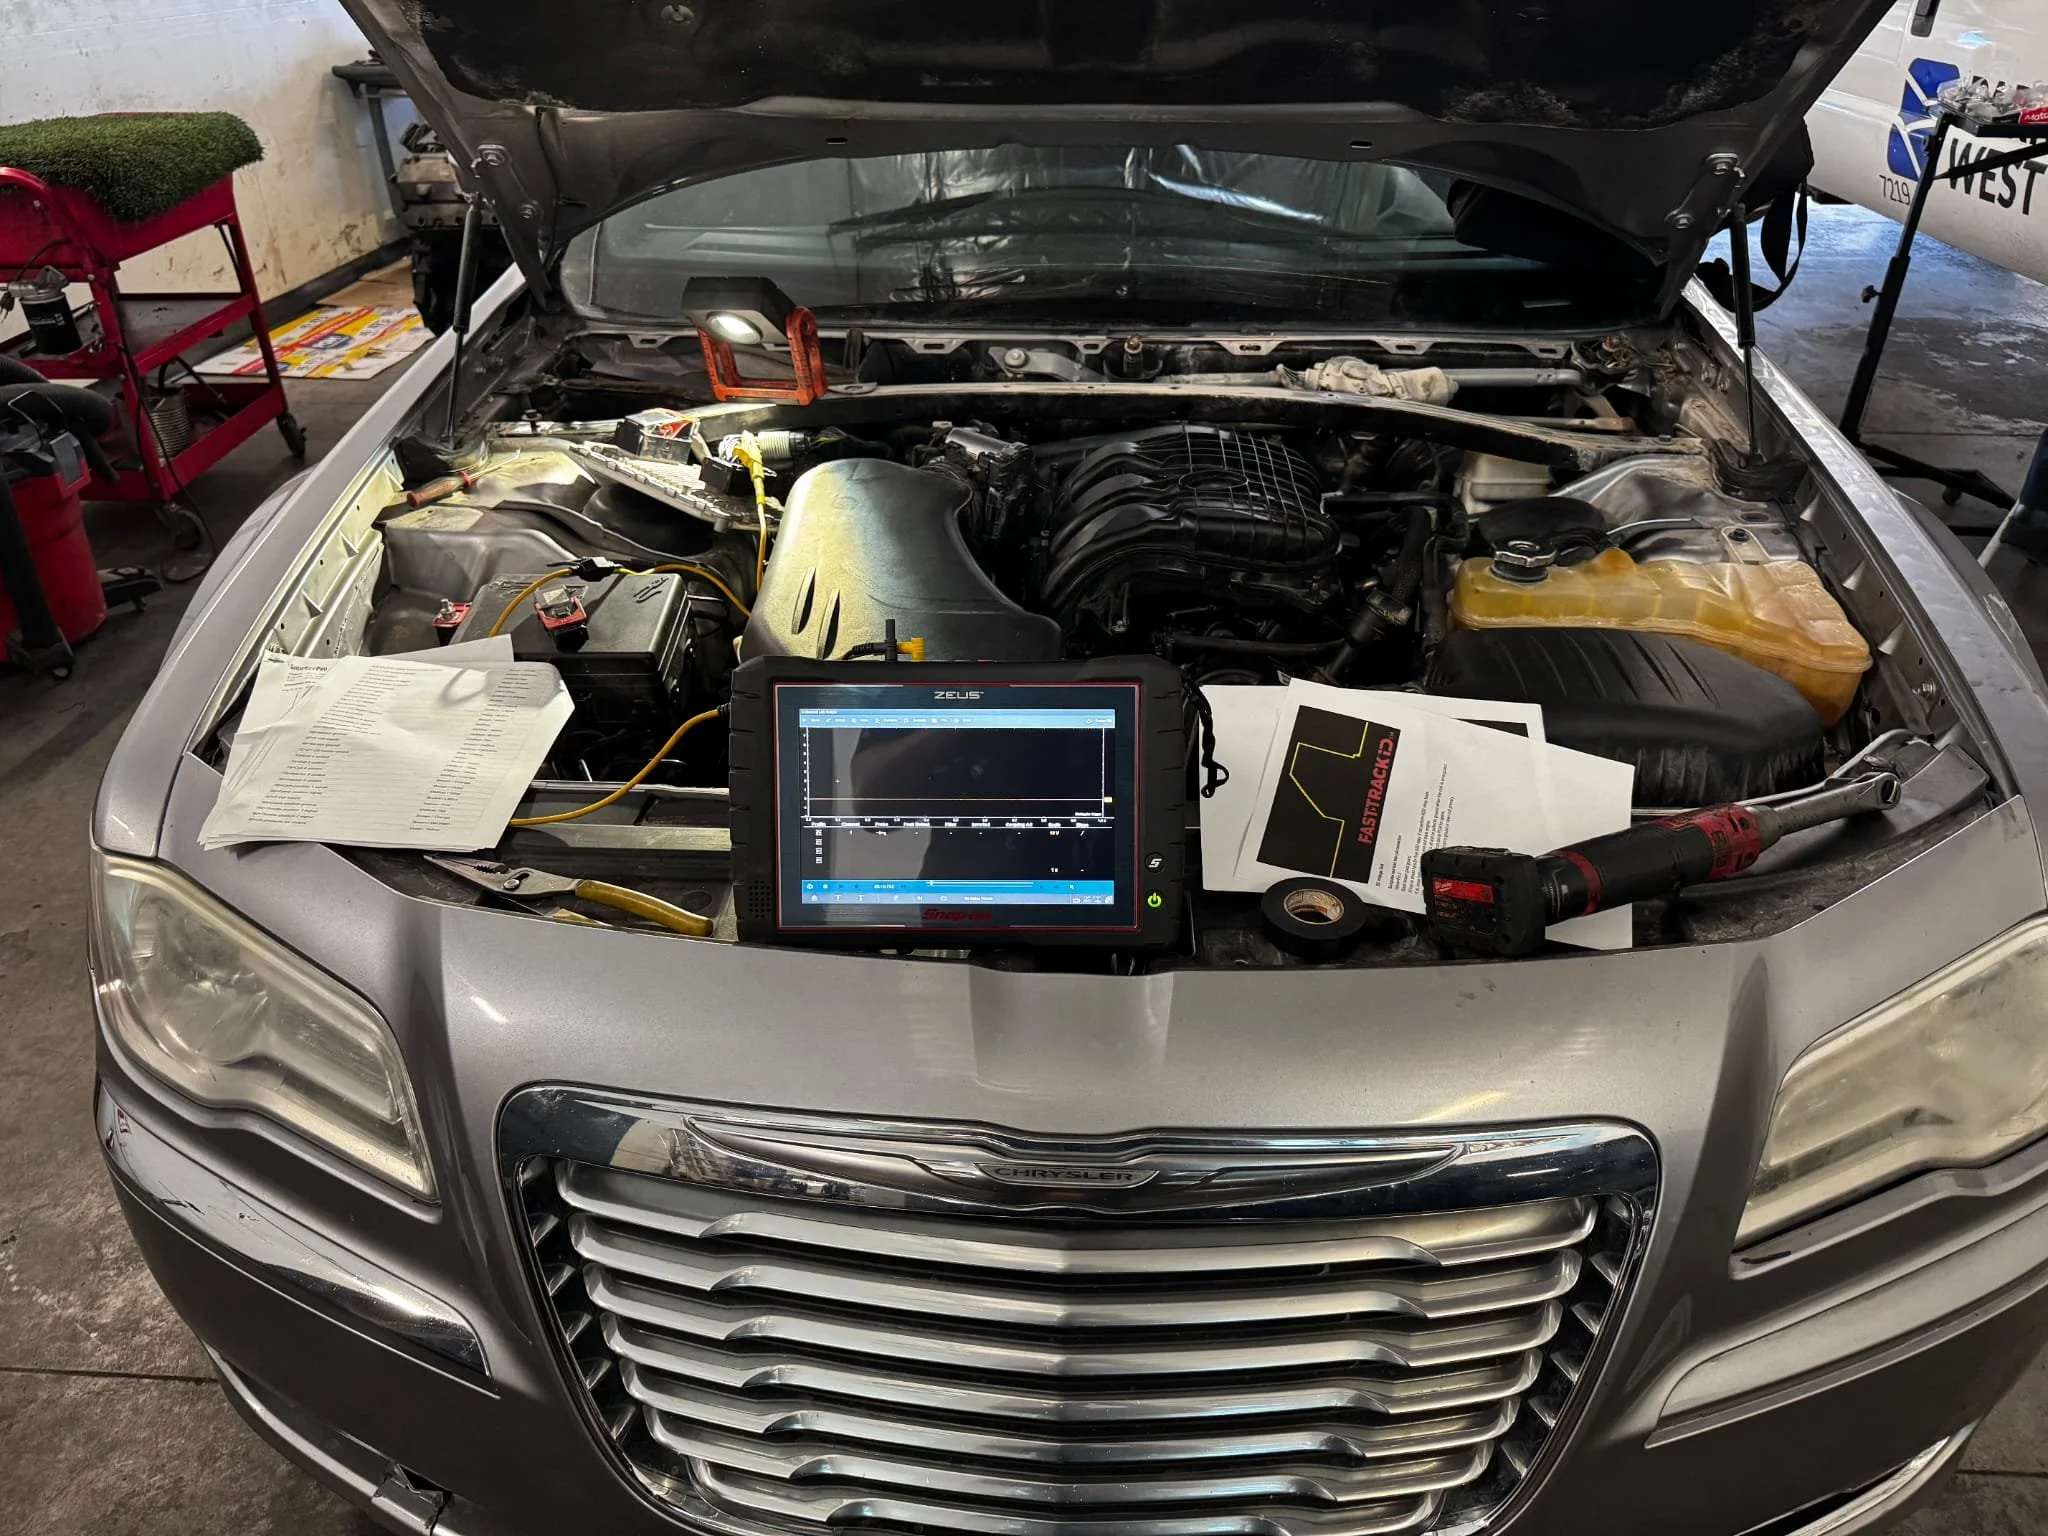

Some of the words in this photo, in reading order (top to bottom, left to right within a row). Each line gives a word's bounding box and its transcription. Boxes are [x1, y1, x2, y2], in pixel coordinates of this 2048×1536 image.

[1950, 138, 2048, 215] WEST
[1879, 174, 1911, 205] 7219
[934, 691, 980, 700] ZEUS
[994, 1167, 1133, 1181] CHRYSLER
